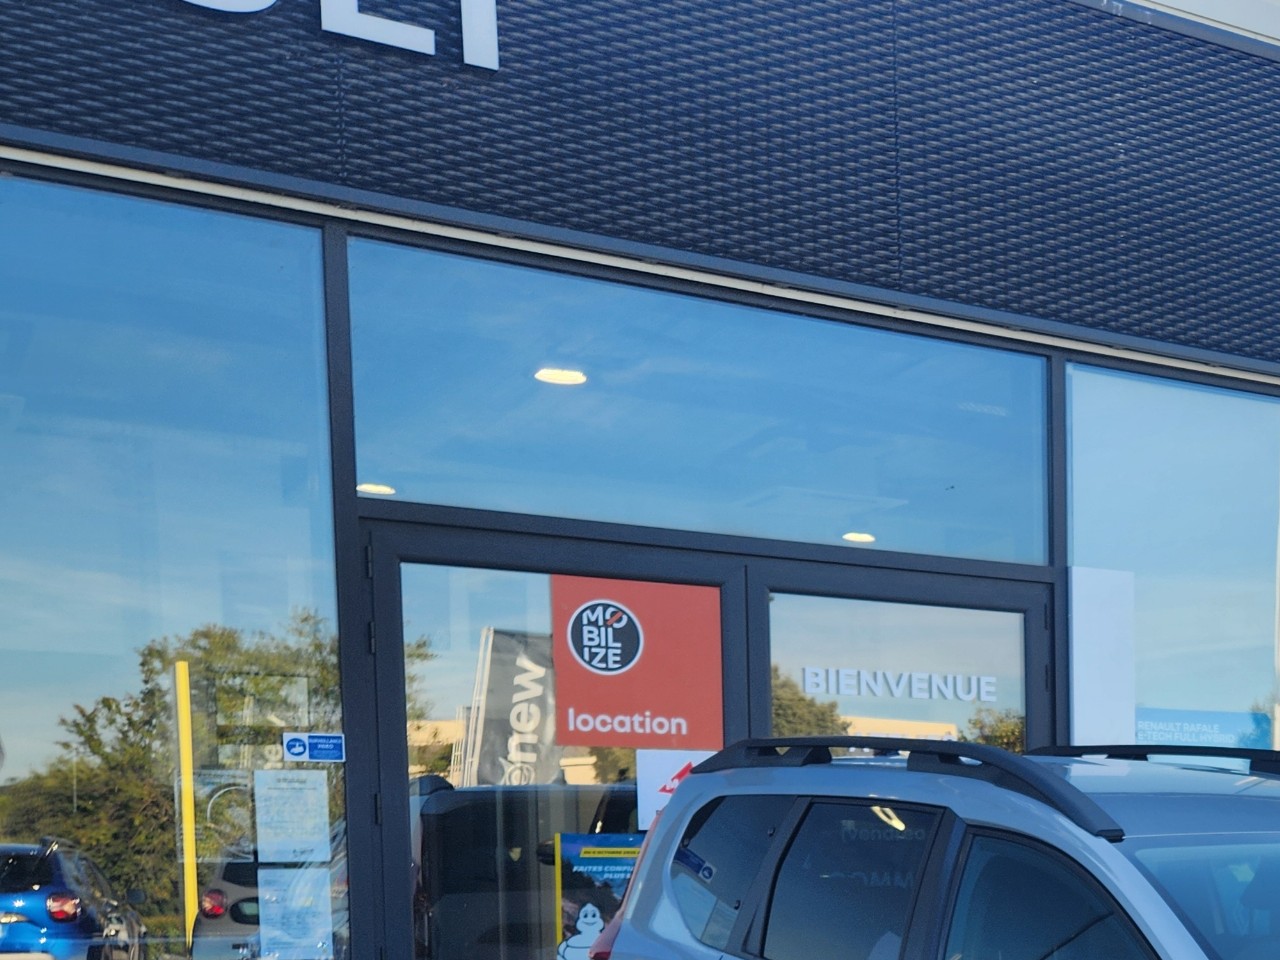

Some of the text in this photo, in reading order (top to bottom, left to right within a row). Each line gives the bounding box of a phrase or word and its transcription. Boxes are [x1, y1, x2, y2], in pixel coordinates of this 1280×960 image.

[582, 626, 622, 648] BIL
[583, 648, 622, 669] IZE
[802, 666, 997, 703] BIENVENUE
[568, 707, 688, 736] location
[1137, 720, 1220, 733] RENAULT RAFALE
[1137, 731, 1236, 744] E-TECH FULL HYBRID
